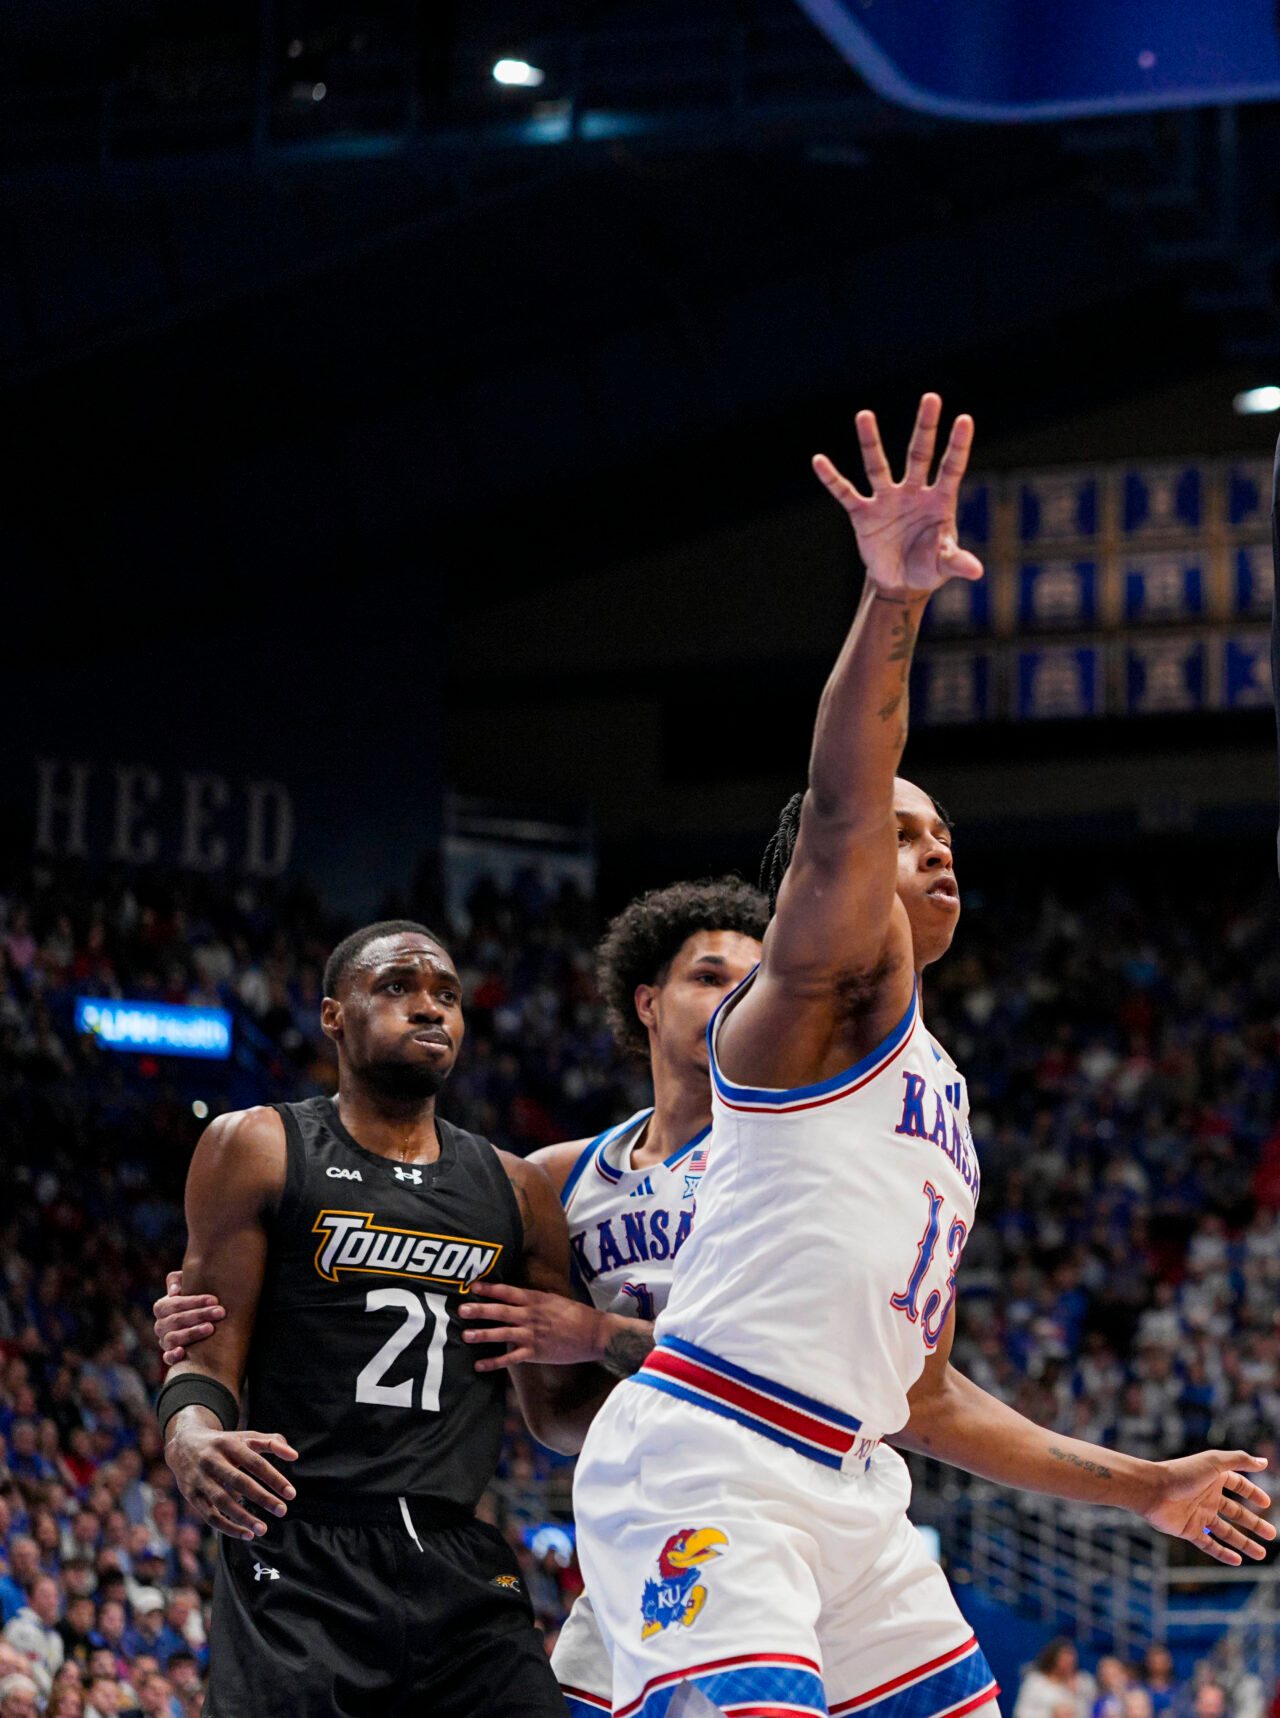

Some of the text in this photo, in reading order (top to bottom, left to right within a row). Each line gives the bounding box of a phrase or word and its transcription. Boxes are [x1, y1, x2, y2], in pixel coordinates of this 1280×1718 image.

[33, 755, 295, 876] HEED
[325, 1167, 363, 1182] CAA
[569, 1200, 697, 1282] KANSA
[890, 1180, 967, 1349] 13
[355, 1288, 450, 1412] 21
[658, 1585, 681, 1608] KU
